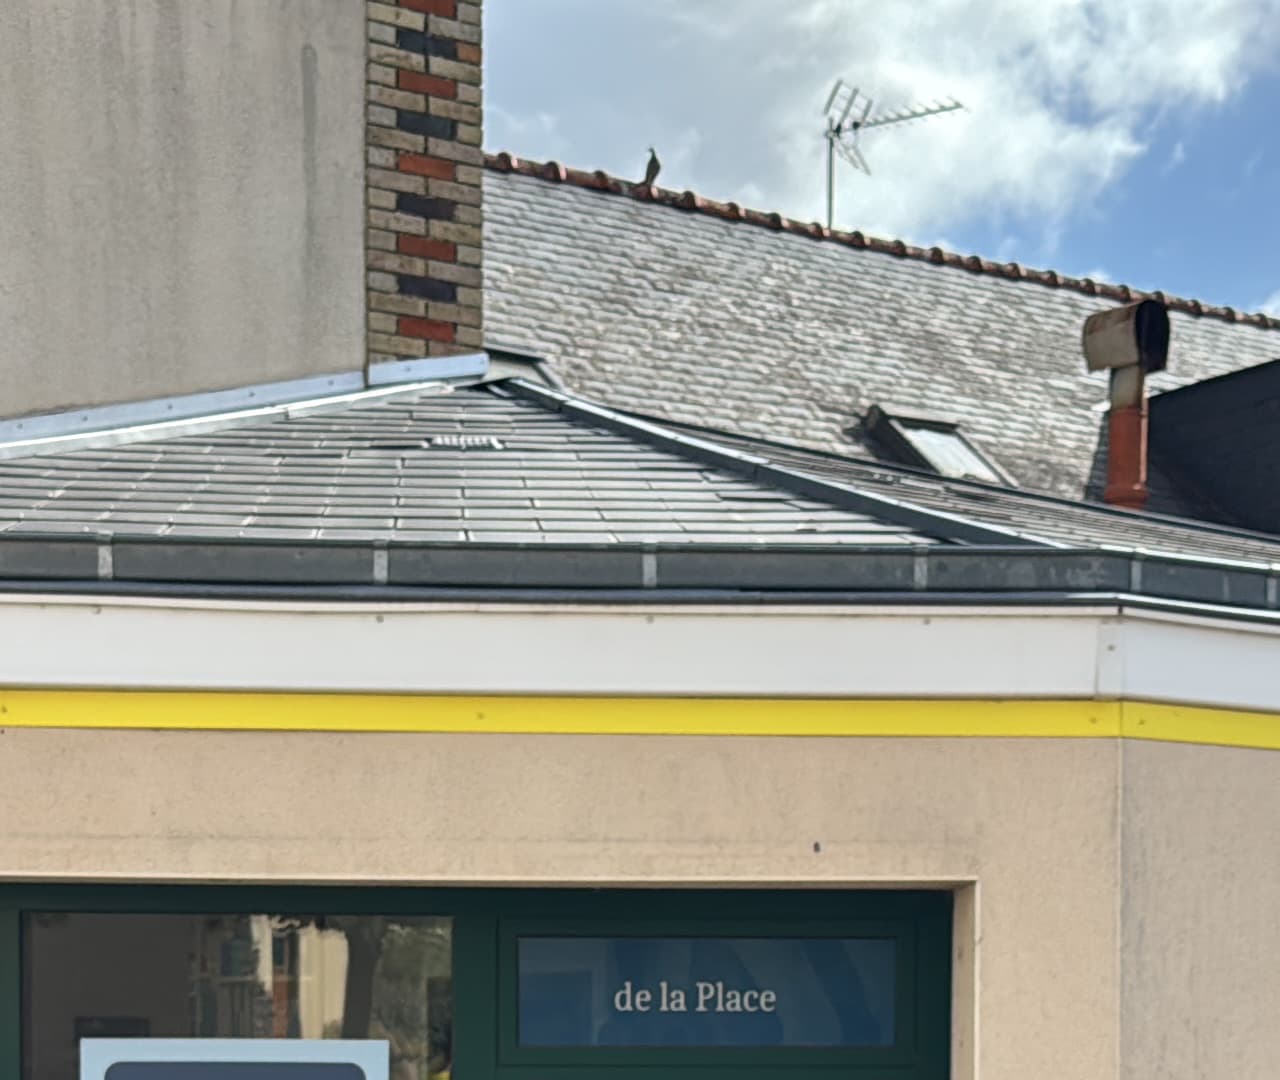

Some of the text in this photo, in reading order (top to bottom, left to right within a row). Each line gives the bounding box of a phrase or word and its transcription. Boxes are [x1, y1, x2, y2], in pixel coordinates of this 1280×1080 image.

[614, 981, 777, 1012] de la Place
